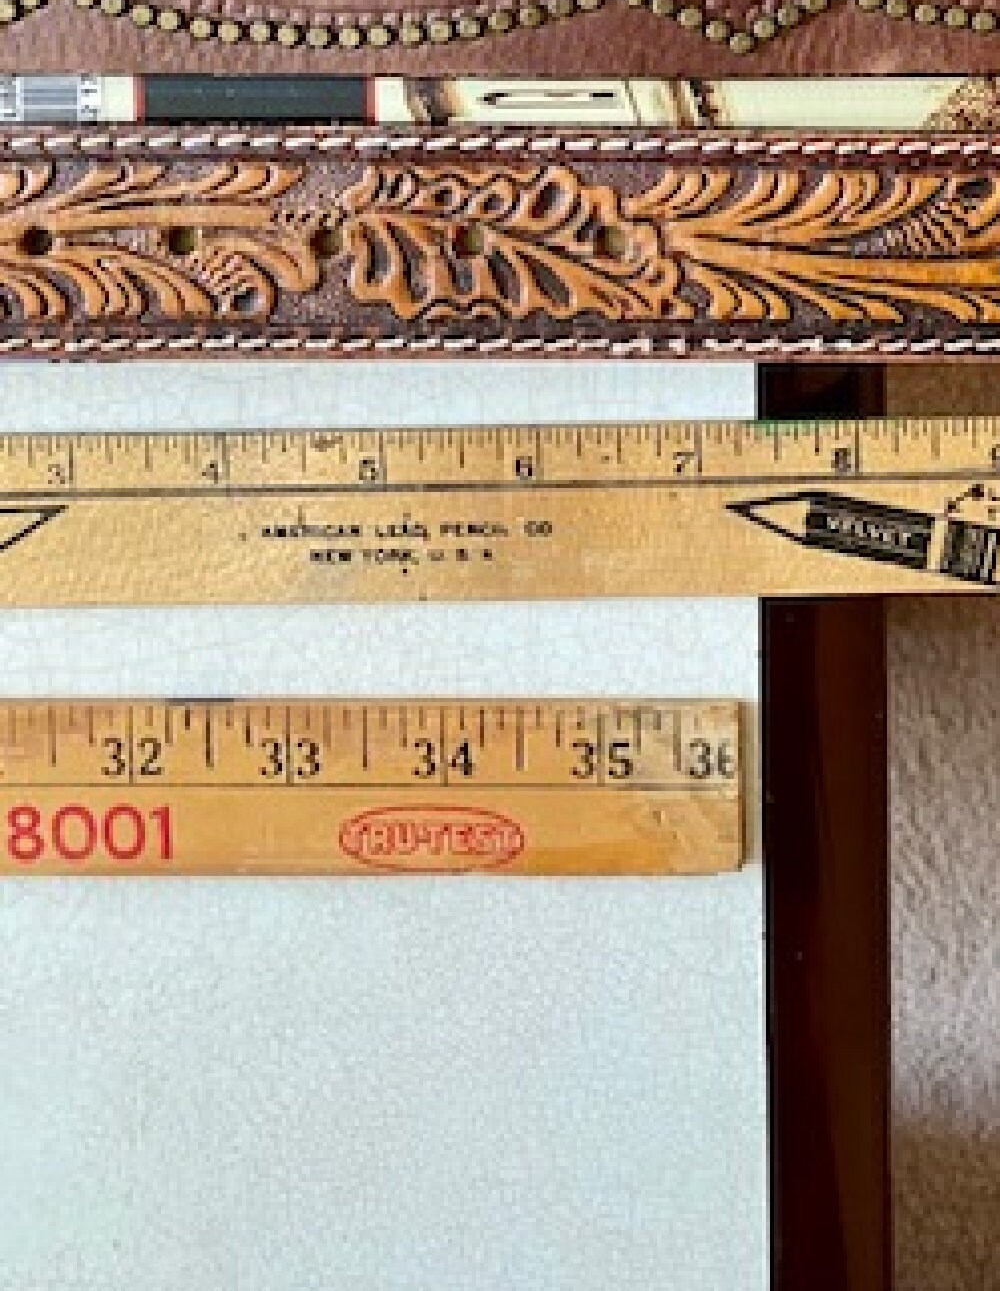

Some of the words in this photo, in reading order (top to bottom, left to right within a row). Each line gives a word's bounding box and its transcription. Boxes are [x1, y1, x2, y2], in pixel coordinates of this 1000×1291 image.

[46, 463, 67, 485] 3
[200, 461, 221, 483] 4
[357, 458, 378, 482] 5
[515, 456, 534, 479] 6
[672, 451, 694, 474] 7
[831, 448, 852, 473] 8
[101, 737, 164, 776] 32
[259, 737, 322, 779] 33
[411, 737, 476, 778] 34
[571, 737, 634, 778] 35
[687, 737, 734, 779] 36
[6, 804, 174, 862] 8001
